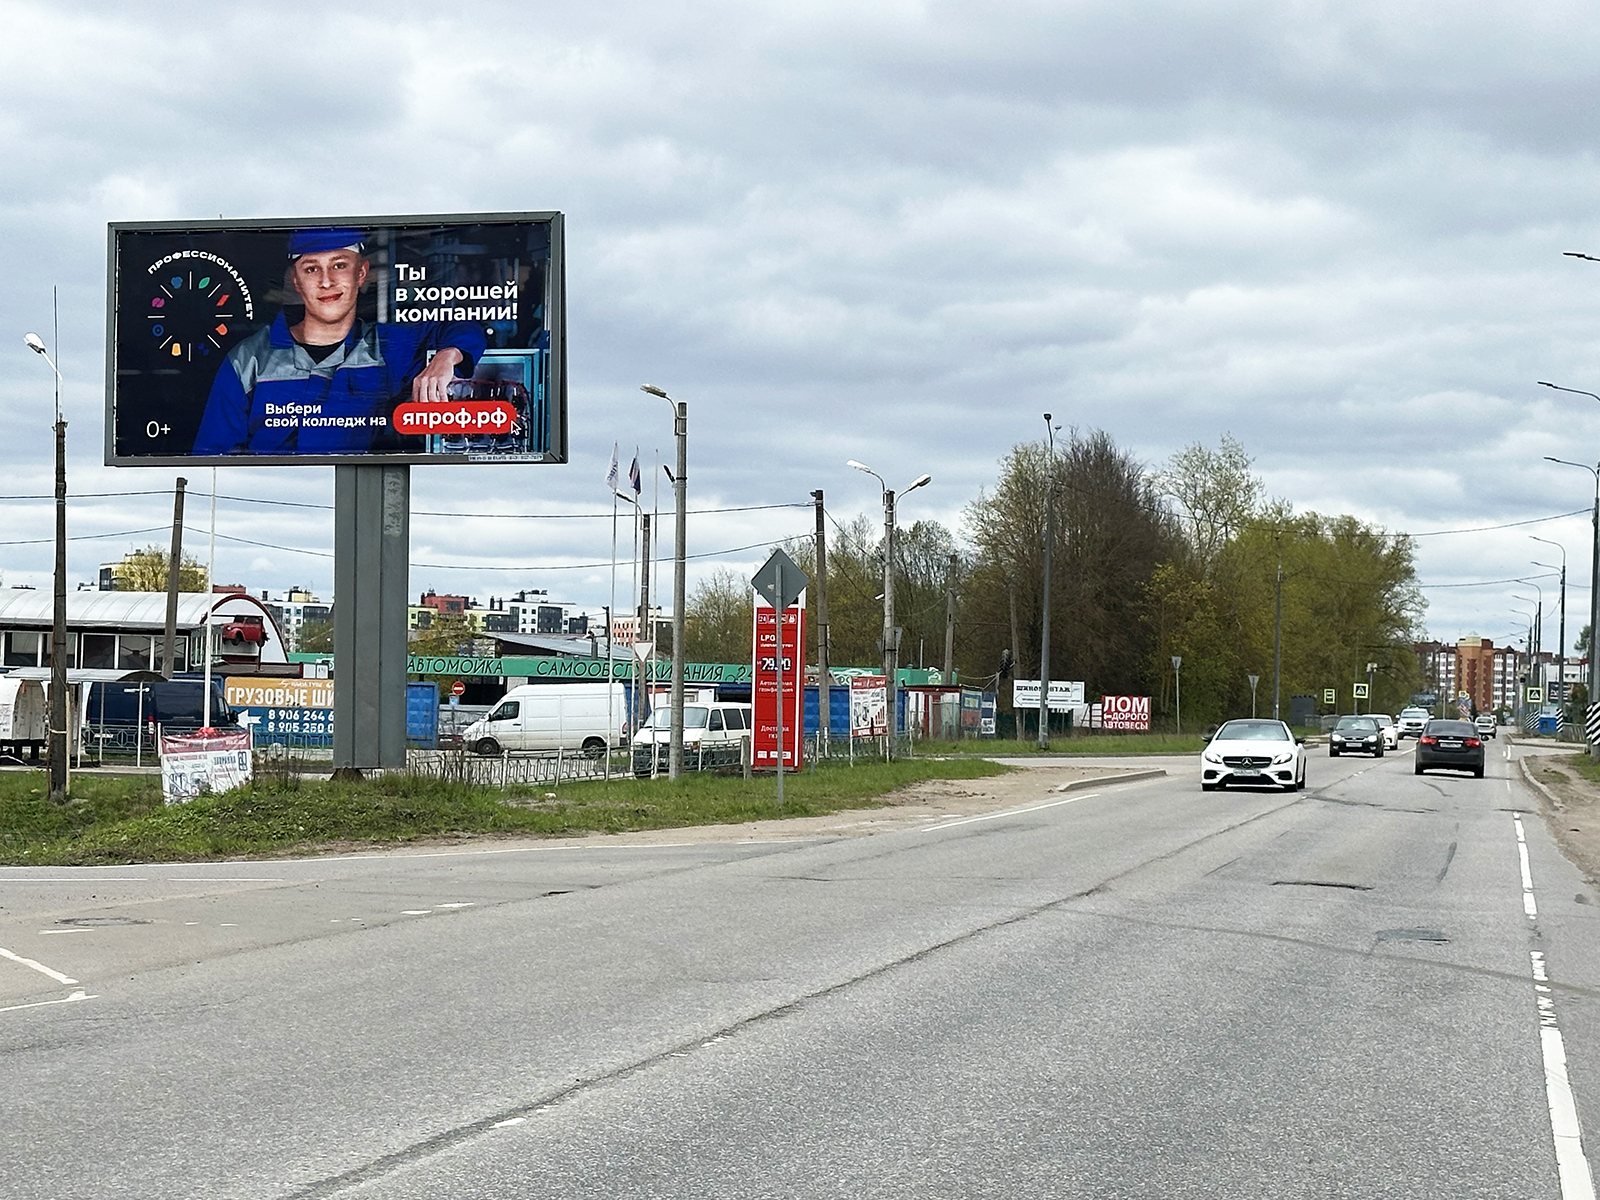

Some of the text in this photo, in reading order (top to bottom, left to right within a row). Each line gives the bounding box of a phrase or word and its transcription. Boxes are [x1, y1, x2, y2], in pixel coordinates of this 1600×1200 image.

[394, 263, 426, 281] Ты
[147, 250, 254, 320] ПРОФЕССИОНАЛИТЕТ
[395, 280, 518, 305] в хорошей
[395, 302, 518, 322] компании!
[265, 402, 322, 416] Выбери
[264, 415, 387, 428] свой колледж на
[402, 407, 508, 429] япроф.рф
[146, 420, 171, 438] 0+
[760, 634, 776, 642] LPG
[406, 657, 503, 675] АВТОМОЙКА
[536, 660, 723, 682] САМООБСЛУЖИАНИЯ
[761, 657, 791, 671] 79.0
[227, 687, 308, 706] ГРУЗОВЫЕ
[1103, 696, 1148, 713] ЛОМ
[268, 709, 276, 720] 8
[279, 710, 300, 720] 906
[303, 711, 325, 721] 264
[1112, 712, 1149, 721] ДОРОГО
[268, 721, 275, 732] 8
[760, 725, 790, 733] Достка
[1102, 720, 1149, 730] АВТОВЕСЫ
